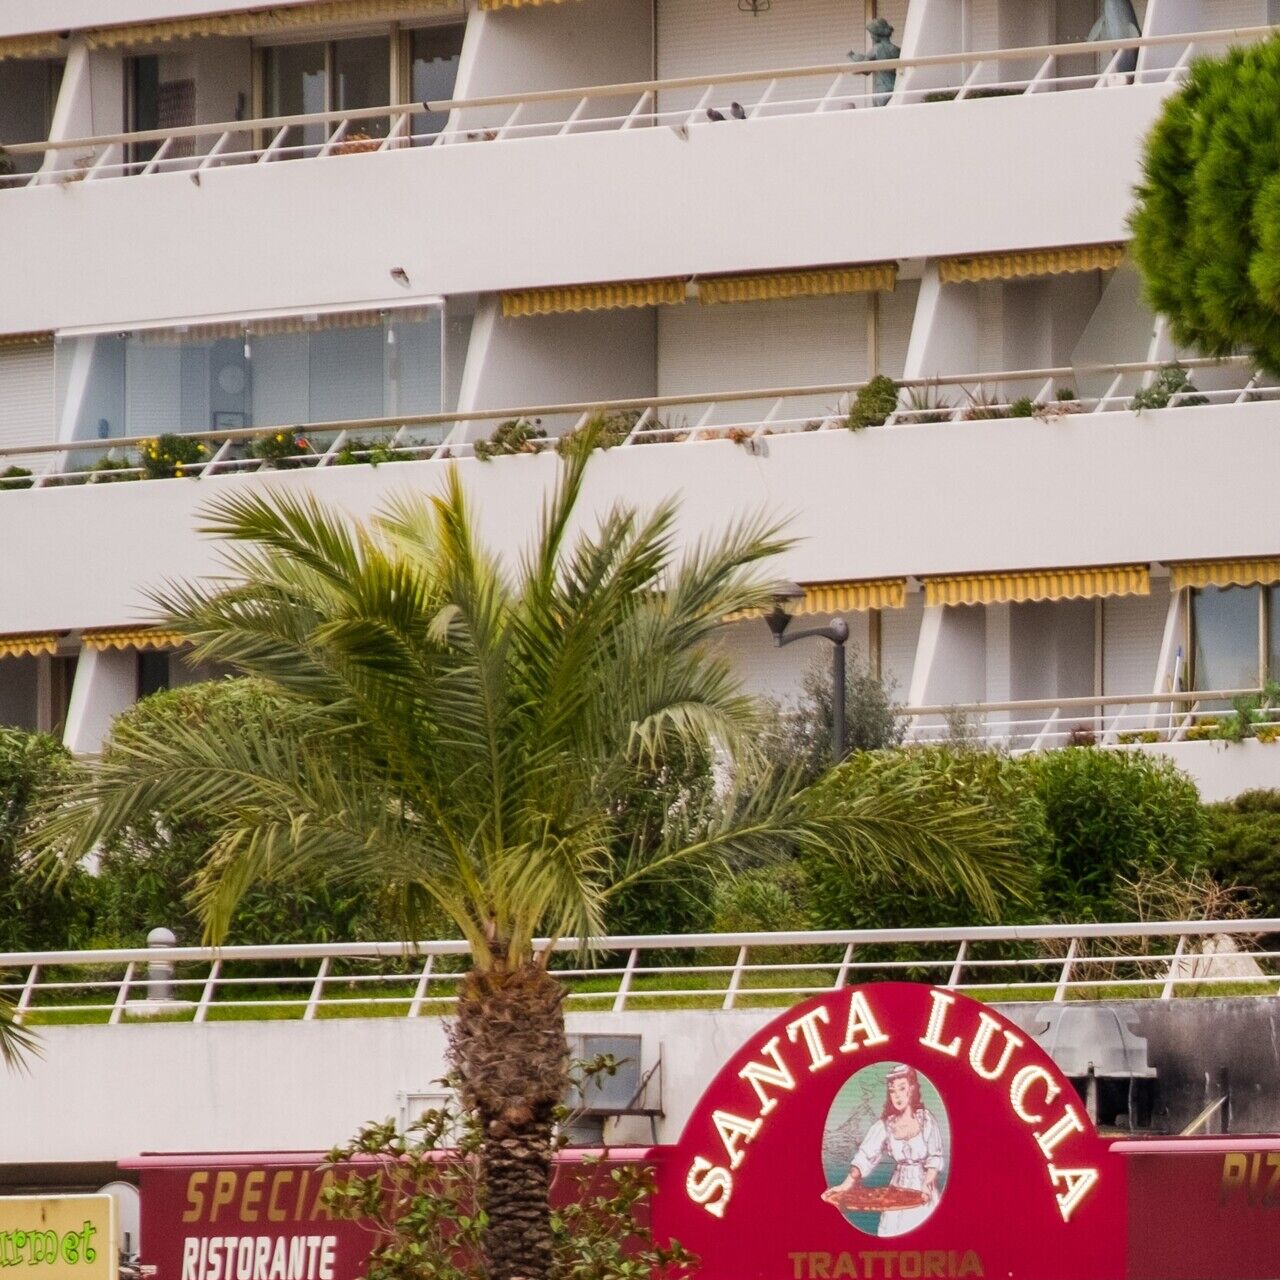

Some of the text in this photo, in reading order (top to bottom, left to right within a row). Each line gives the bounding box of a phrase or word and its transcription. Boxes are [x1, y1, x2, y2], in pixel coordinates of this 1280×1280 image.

[685, 989, 1100, 1223] SANTA LUCIA
[788, 1249, 984, 1280] TRATTORIA
